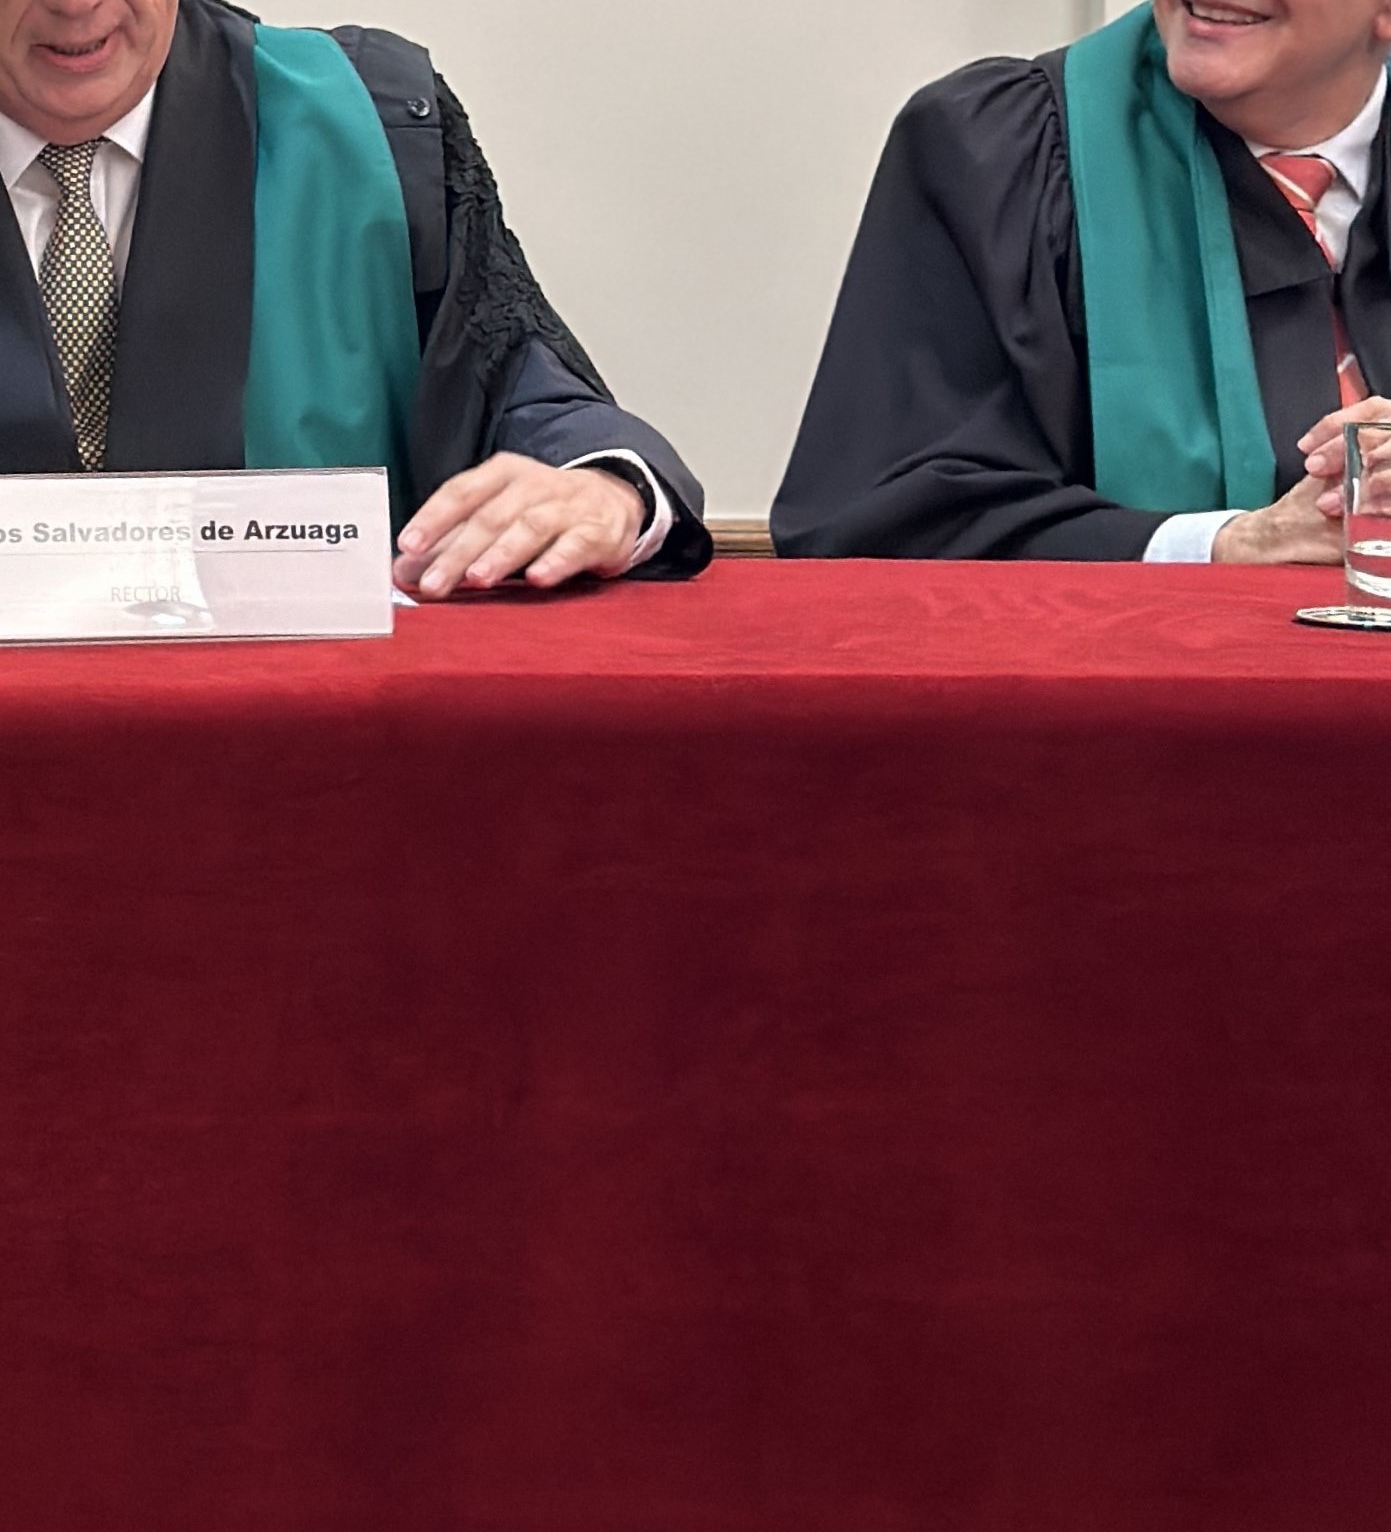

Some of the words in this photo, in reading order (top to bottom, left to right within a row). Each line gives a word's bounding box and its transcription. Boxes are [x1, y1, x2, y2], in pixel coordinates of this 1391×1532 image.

[32, 521, 192, 544] Salvadores
[199, 519, 235, 542] de
[243, 519, 359, 545] Arzuaga
[110, 585, 181, 603] RECTOR
